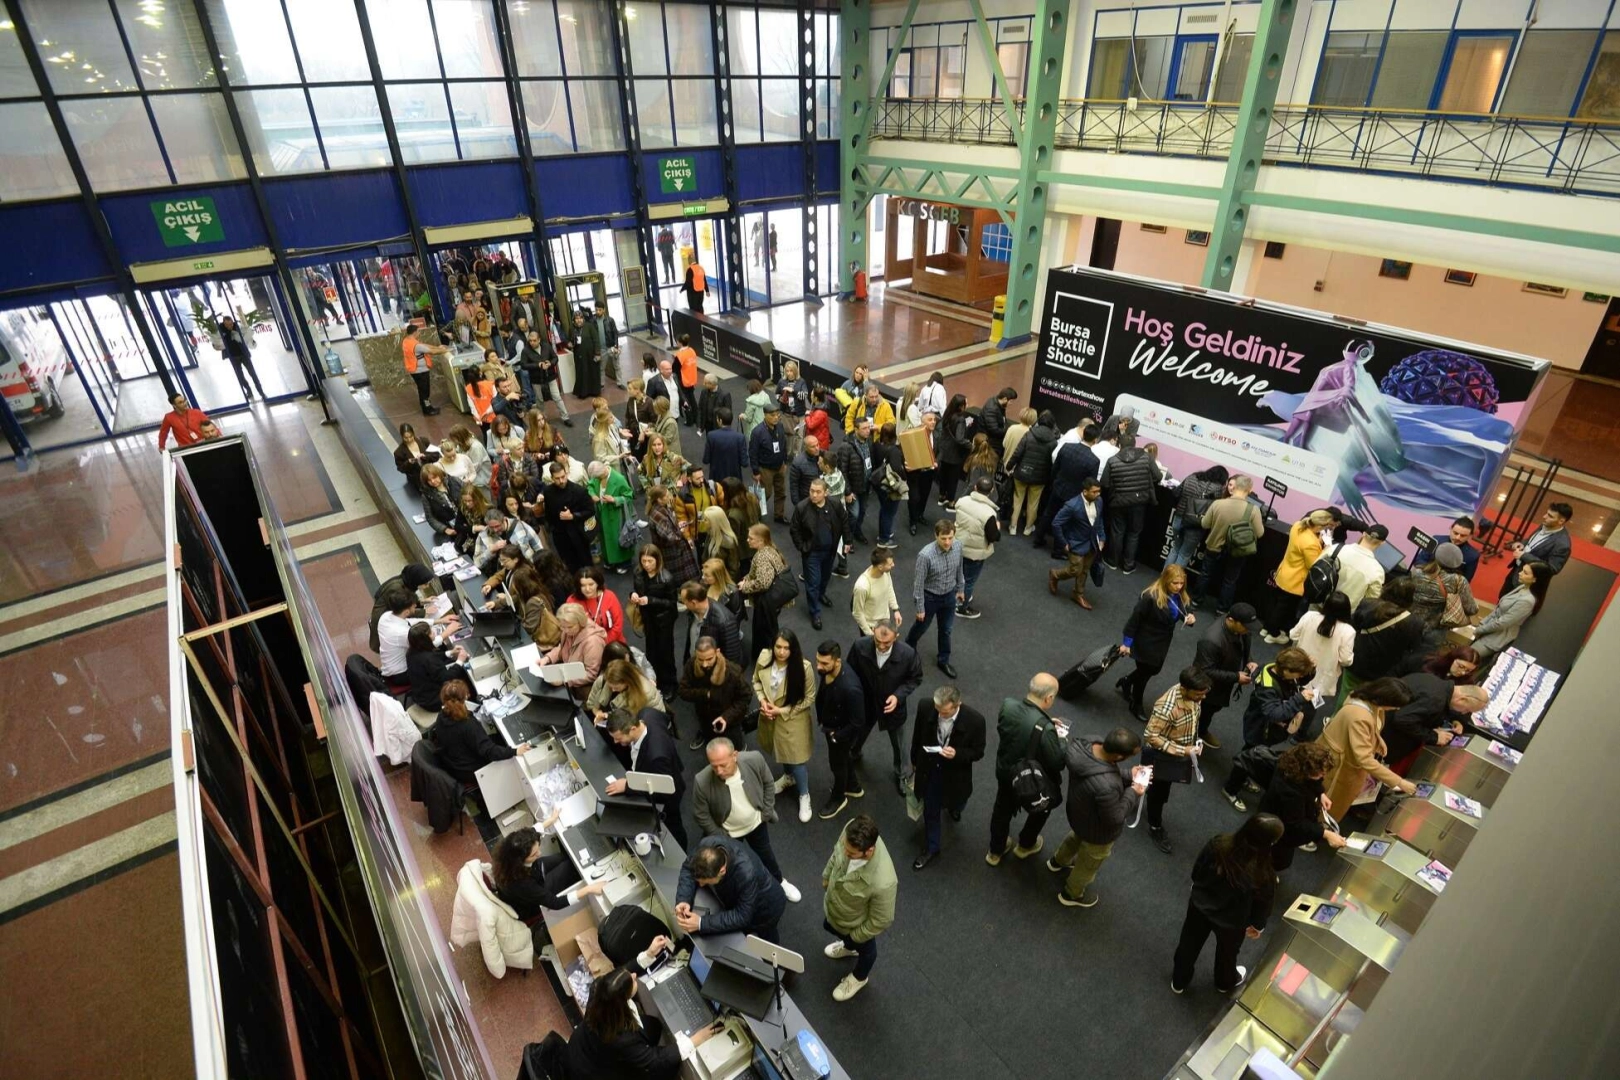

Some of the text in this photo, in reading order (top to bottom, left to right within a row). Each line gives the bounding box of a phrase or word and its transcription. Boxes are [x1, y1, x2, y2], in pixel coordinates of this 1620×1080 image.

[664, 169, 692, 180] ÇIKIŞ
[164, 212, 213, 229] ÇIKIŞ
[1050, 316, 1091, 339] Bursa
[1049, 331, 1096, 356] Textile
[1124, 307, 1305, 374] Hoş Geldiniz
[1046, 346, 1086, 368] Show
[1128, 338, 1275, 396] Welcome
